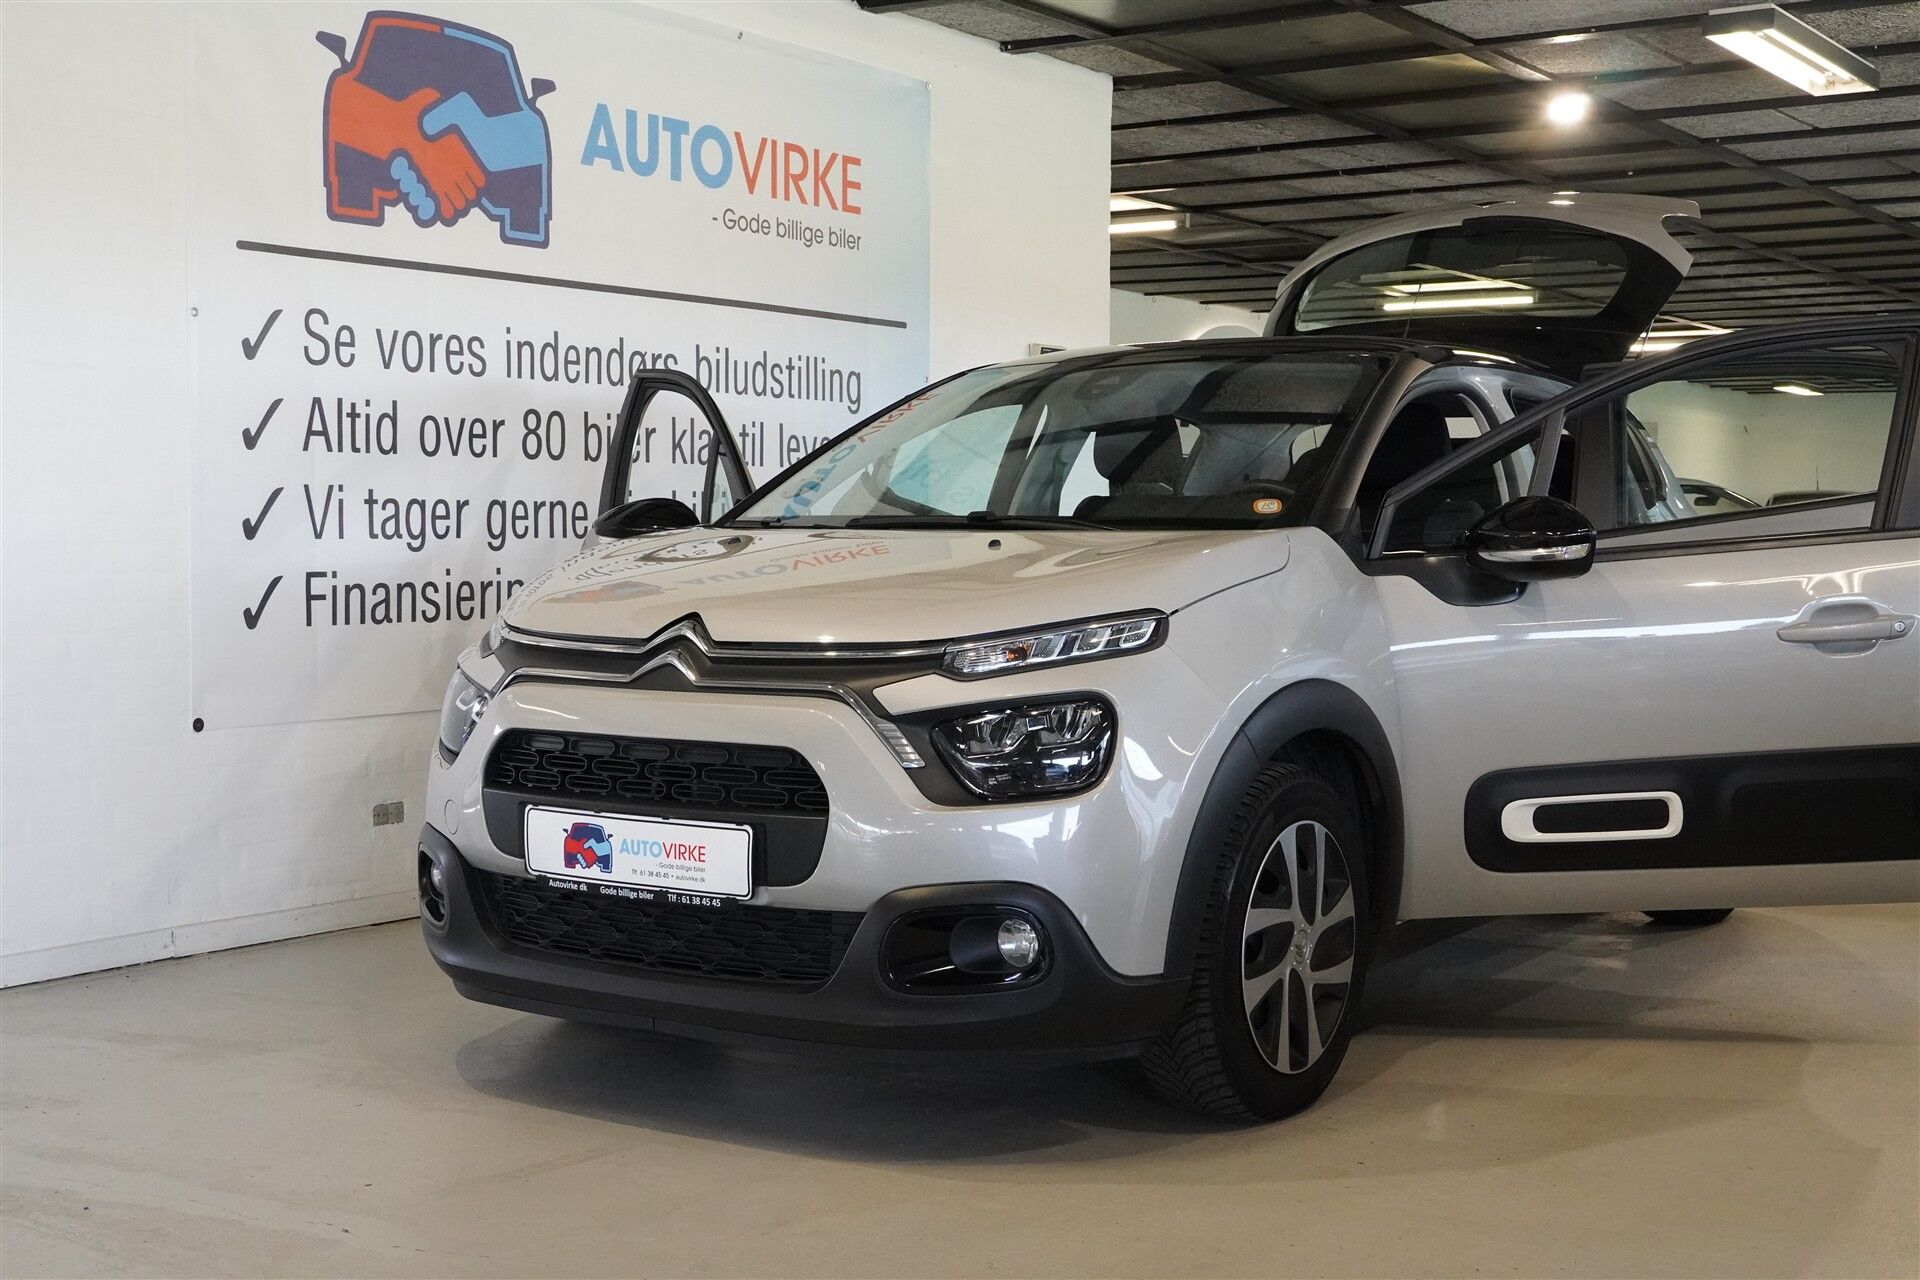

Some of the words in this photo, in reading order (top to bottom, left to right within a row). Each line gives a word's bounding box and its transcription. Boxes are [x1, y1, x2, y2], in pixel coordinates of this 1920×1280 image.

[580, 102, 861, 215] AUTOVIRKE
[722, 208, 771, 236] Gode
[776, 216, 824, 249] billige
[828, 226, 861, 251] biler
[303, 308, 356, 368] Se
[375, 328, 487, 378] vores
[696, 343, 861, 415] biludstilling
[302, 396, 398, 456] Altid
[419, 414, 506, 458] over
[521, 408, 566, 461] 80
[671, 416, 713, 466] kla
[738, 421, 764, 467] til
[304, 484, 344, 540] Vi
[364, 488, 471, 552] tager
[486, 498, 589, 552] gerne
[619, 837, 707, 863] AUTOVIRKE
[659, 861, 675, 870] Gode
[548, 879, 578, 891] Autovirke
[600, 885, 617, 896] Gode
[618, 888, 638, 900] billige
[639, 891, 655, 901] biler
[682, 895, 691, 905] 61
[692, 896, 701, 906] 38
[702, 897, 711, 907] 45
[712, 898, 721, 908] 45
[640, 869, 646, 877] 61
[648, 870, 654, 878] 38
[655, 871, 662, 879] 45
[663, 872, 670, 880] 45
